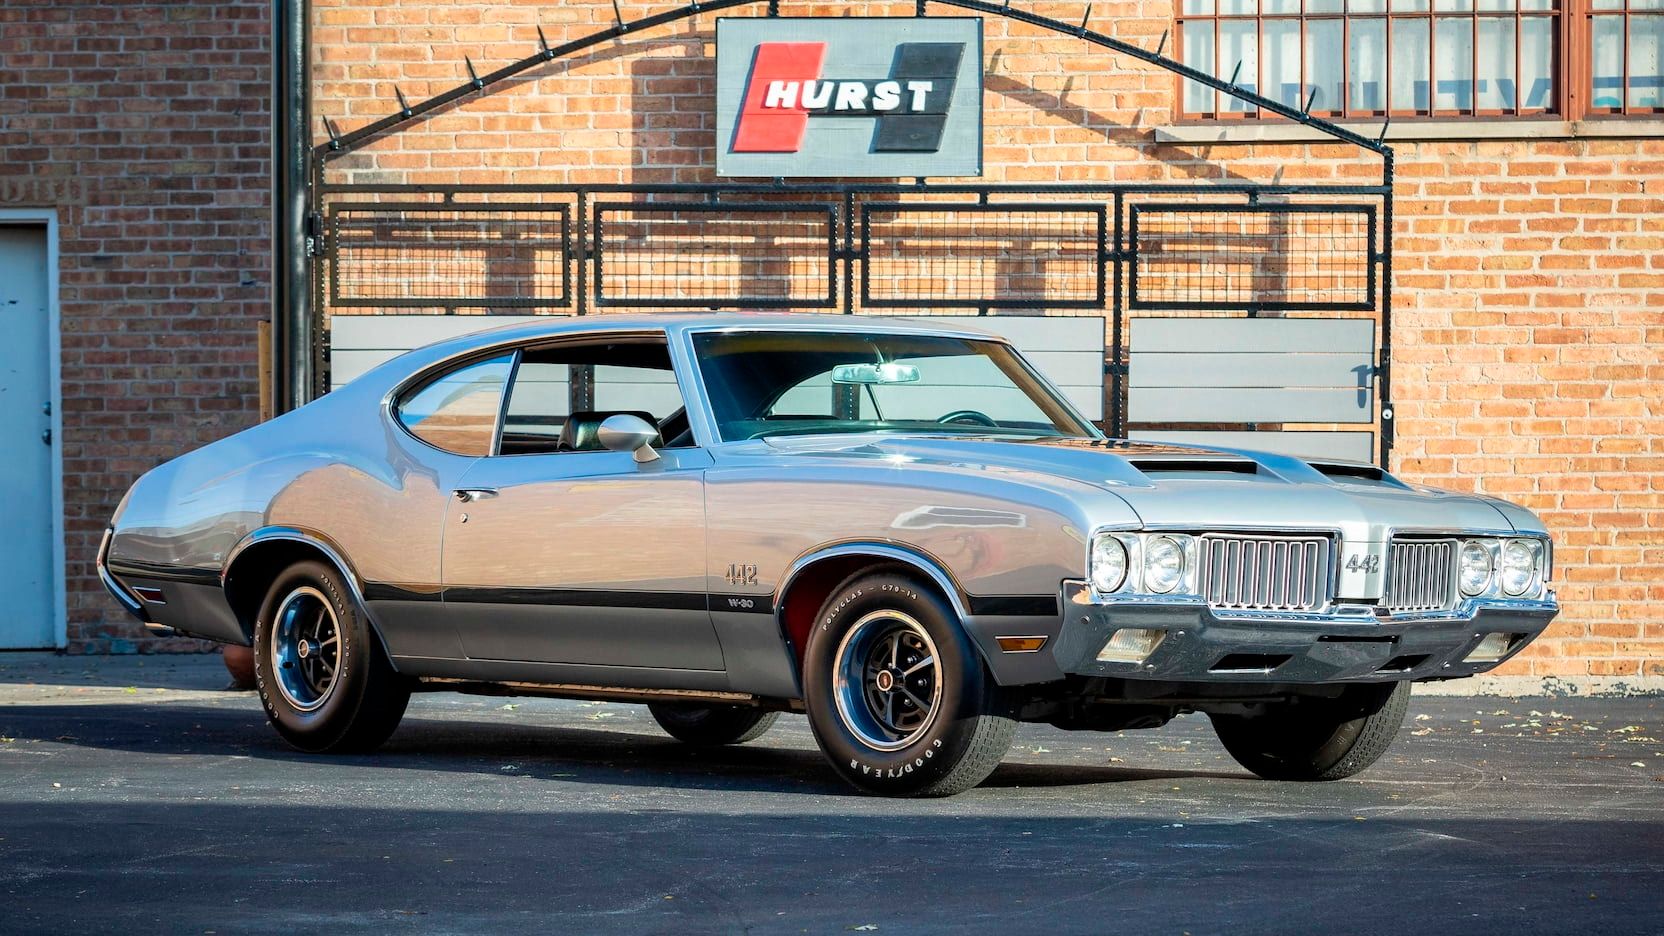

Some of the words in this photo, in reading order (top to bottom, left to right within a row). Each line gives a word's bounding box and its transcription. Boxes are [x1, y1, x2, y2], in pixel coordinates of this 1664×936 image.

[764, 80, 933, 111] HURST
[726, 564, 757, 585] 442
[1345, 554, 1379, 574] 442
[822, 589, 863, 632] POLYGLAS
[881, 584, 918, 600] G70-14
[850, 739, 942, 778] GOODYEAR
